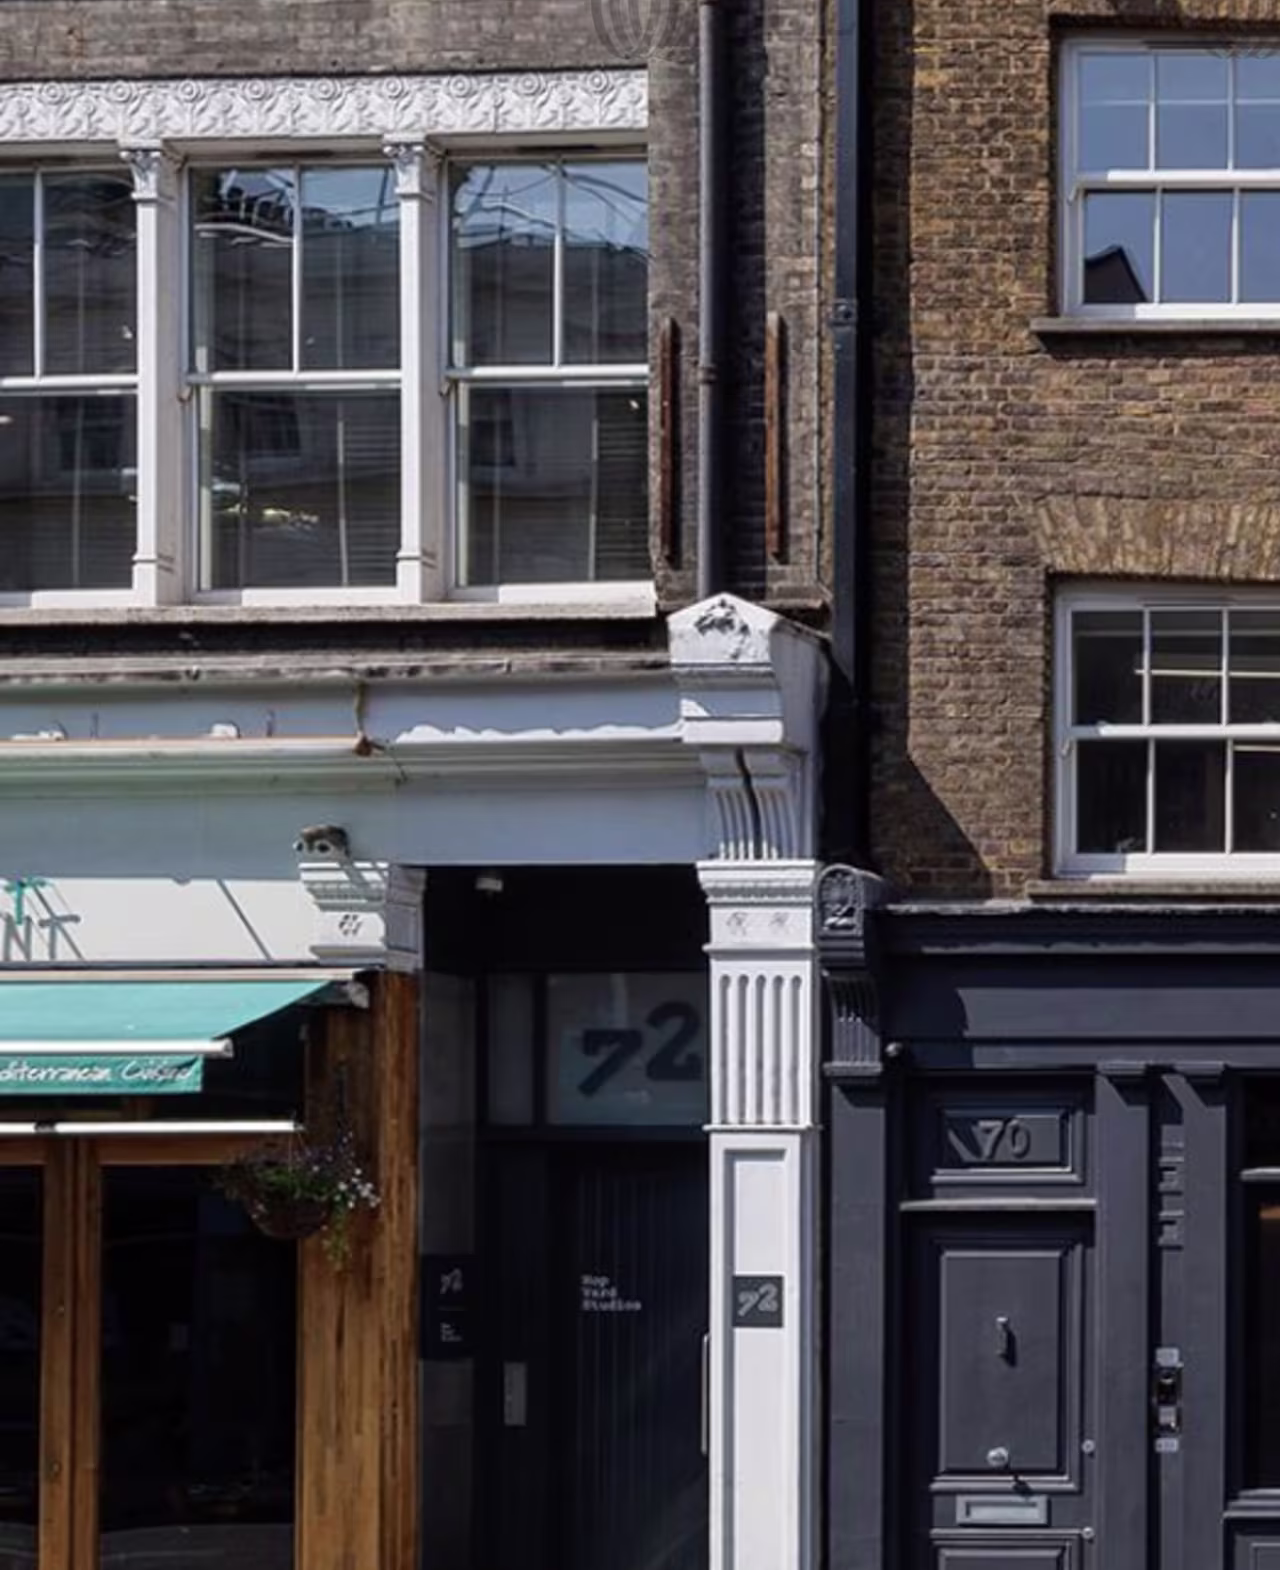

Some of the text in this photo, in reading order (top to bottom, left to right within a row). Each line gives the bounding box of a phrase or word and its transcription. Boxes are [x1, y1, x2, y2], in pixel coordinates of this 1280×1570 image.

[578, 1001, 704, 1099] 72
[977, 1119, 1031, 1160] 70
[737, 1283, 778, 1317] 72
